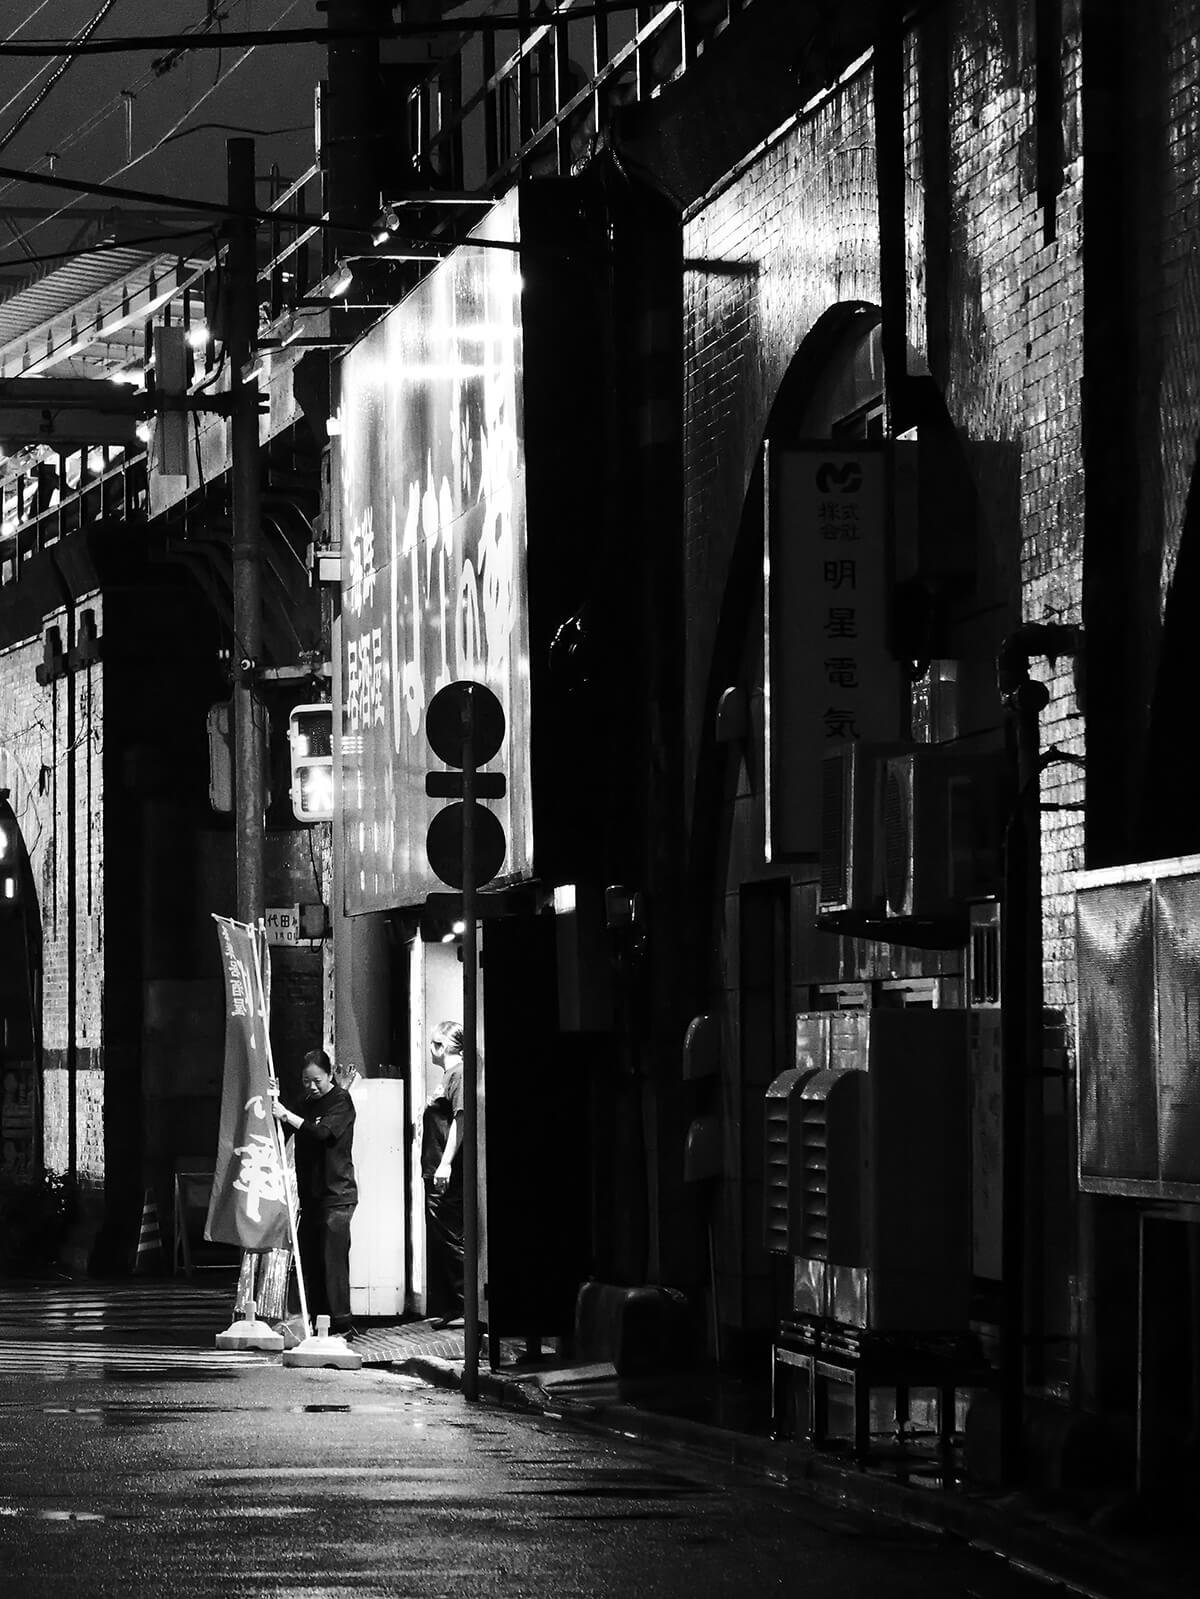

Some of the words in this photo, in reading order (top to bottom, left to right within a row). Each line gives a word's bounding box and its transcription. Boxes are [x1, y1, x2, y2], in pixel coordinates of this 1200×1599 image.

[350, 506, 377, 617] 海鮮
[347, 627, 386, 731] 居酒屋
[822, 559, 861, 740] 明星電気
